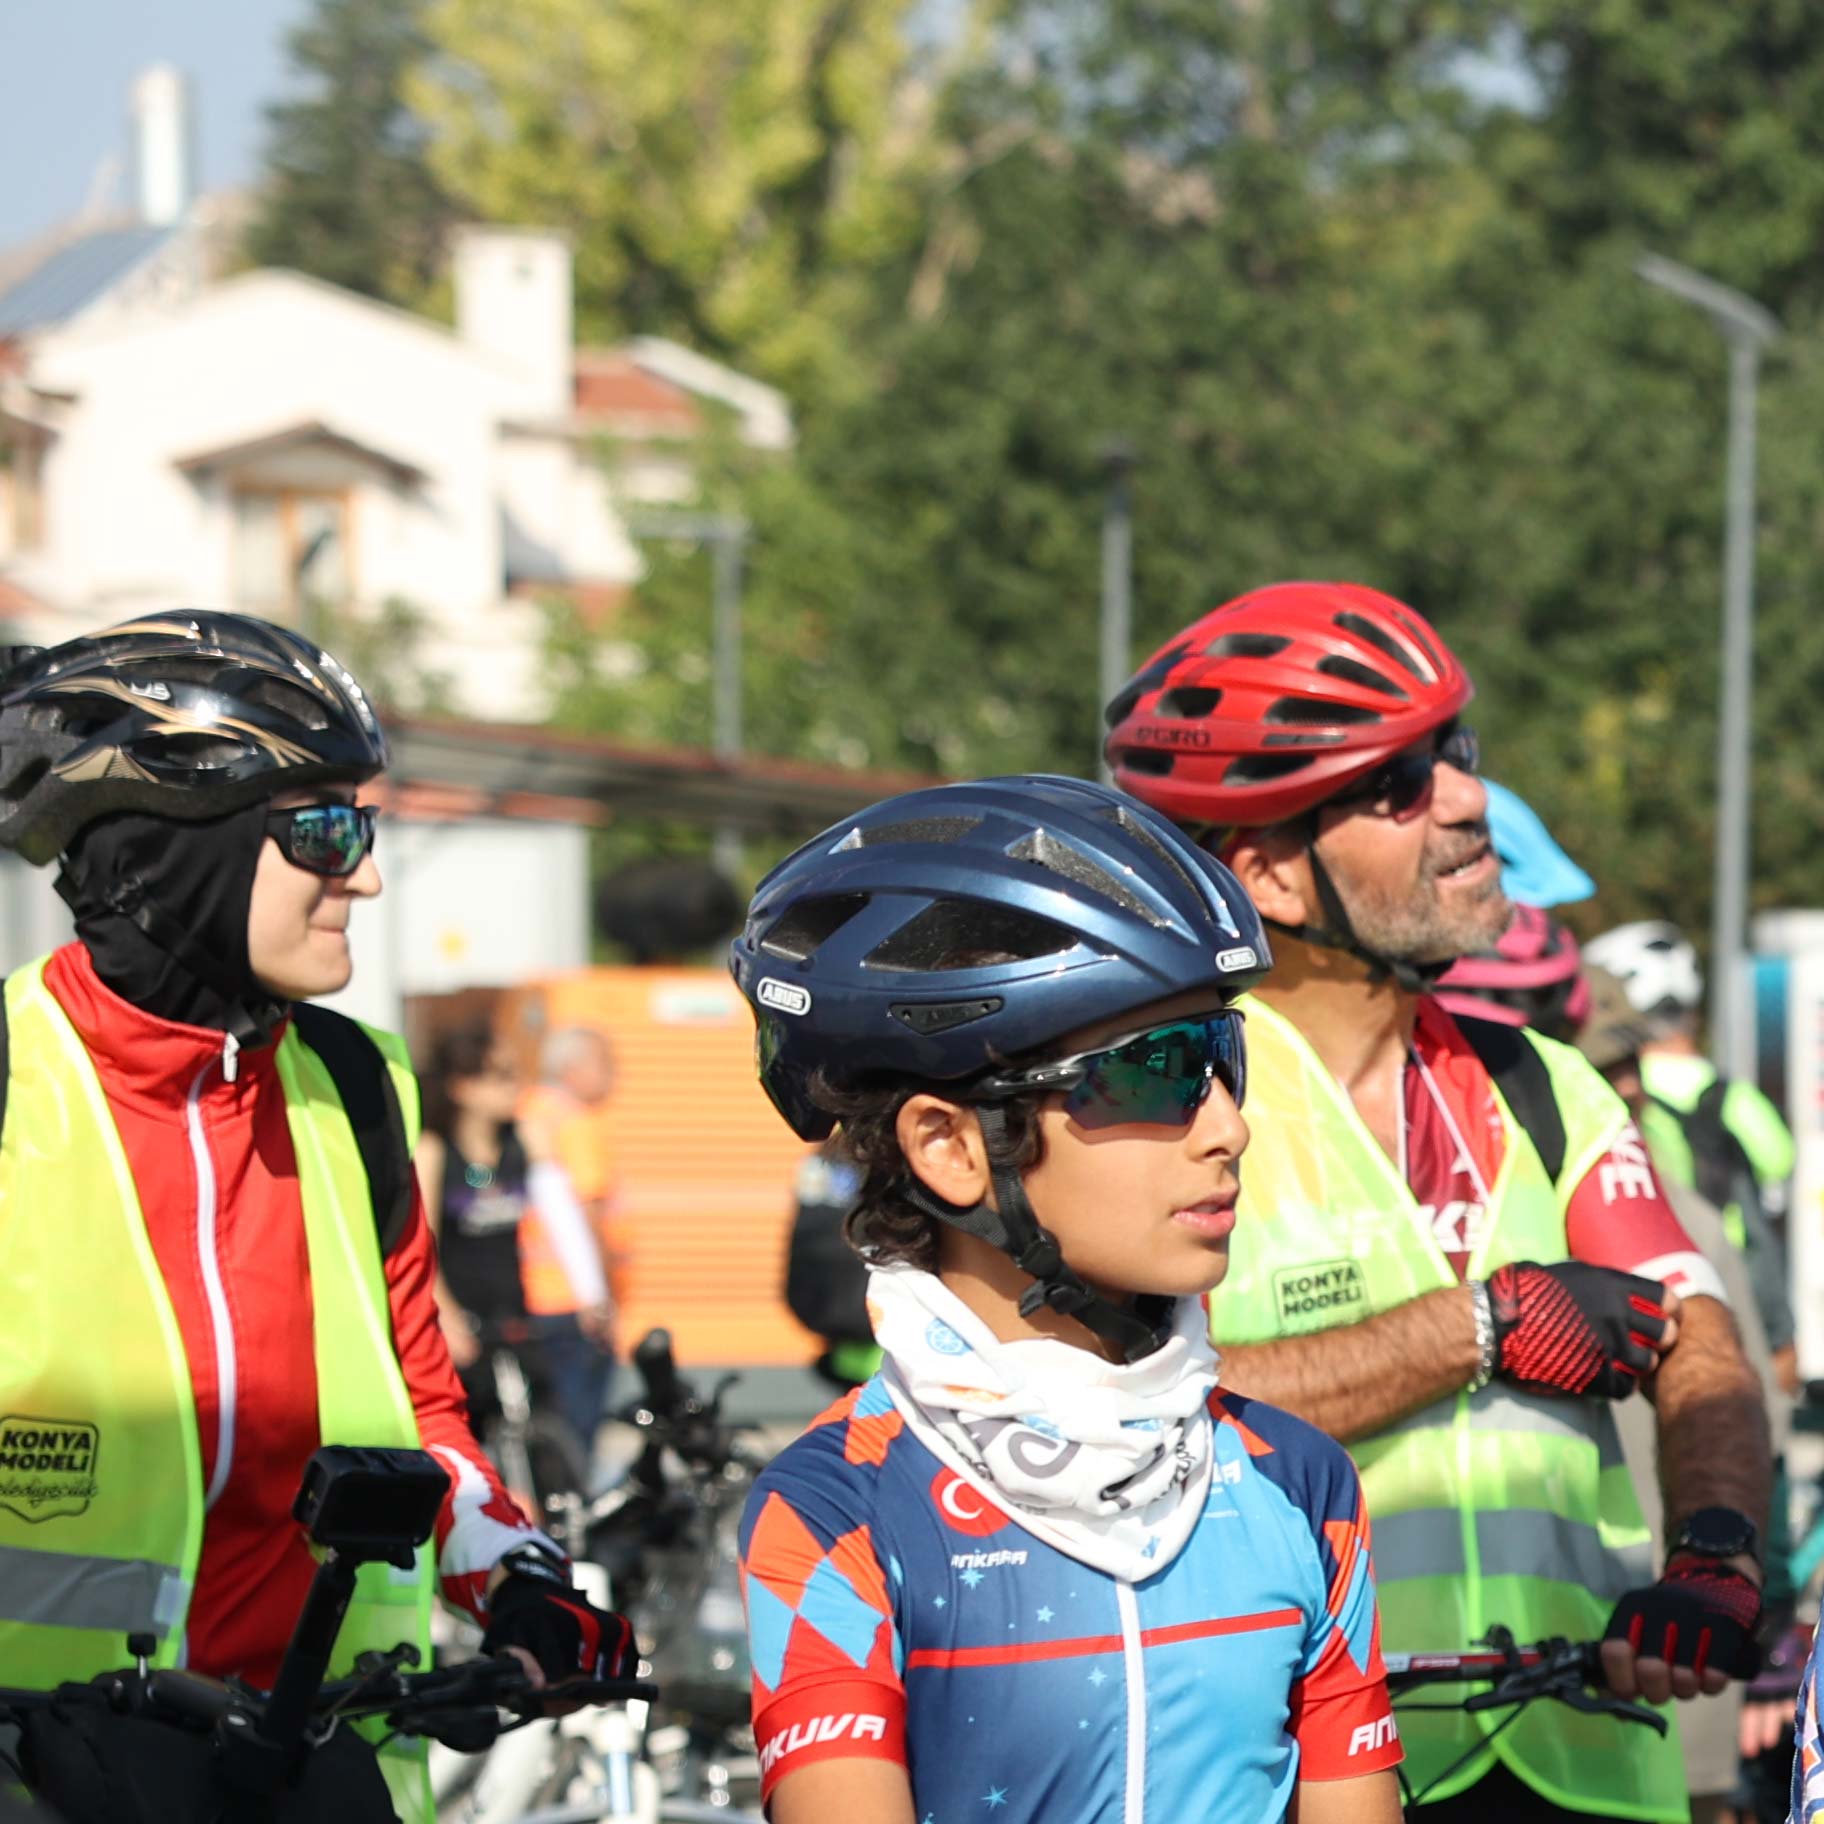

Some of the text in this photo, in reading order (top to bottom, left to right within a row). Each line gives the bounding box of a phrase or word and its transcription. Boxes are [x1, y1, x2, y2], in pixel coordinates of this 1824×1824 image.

[1281, 1265, 1359, 1297] KONYA
[2, 1429, 92, 1450] KONYA
[761, 1712, 888, 1773] NKUVA
